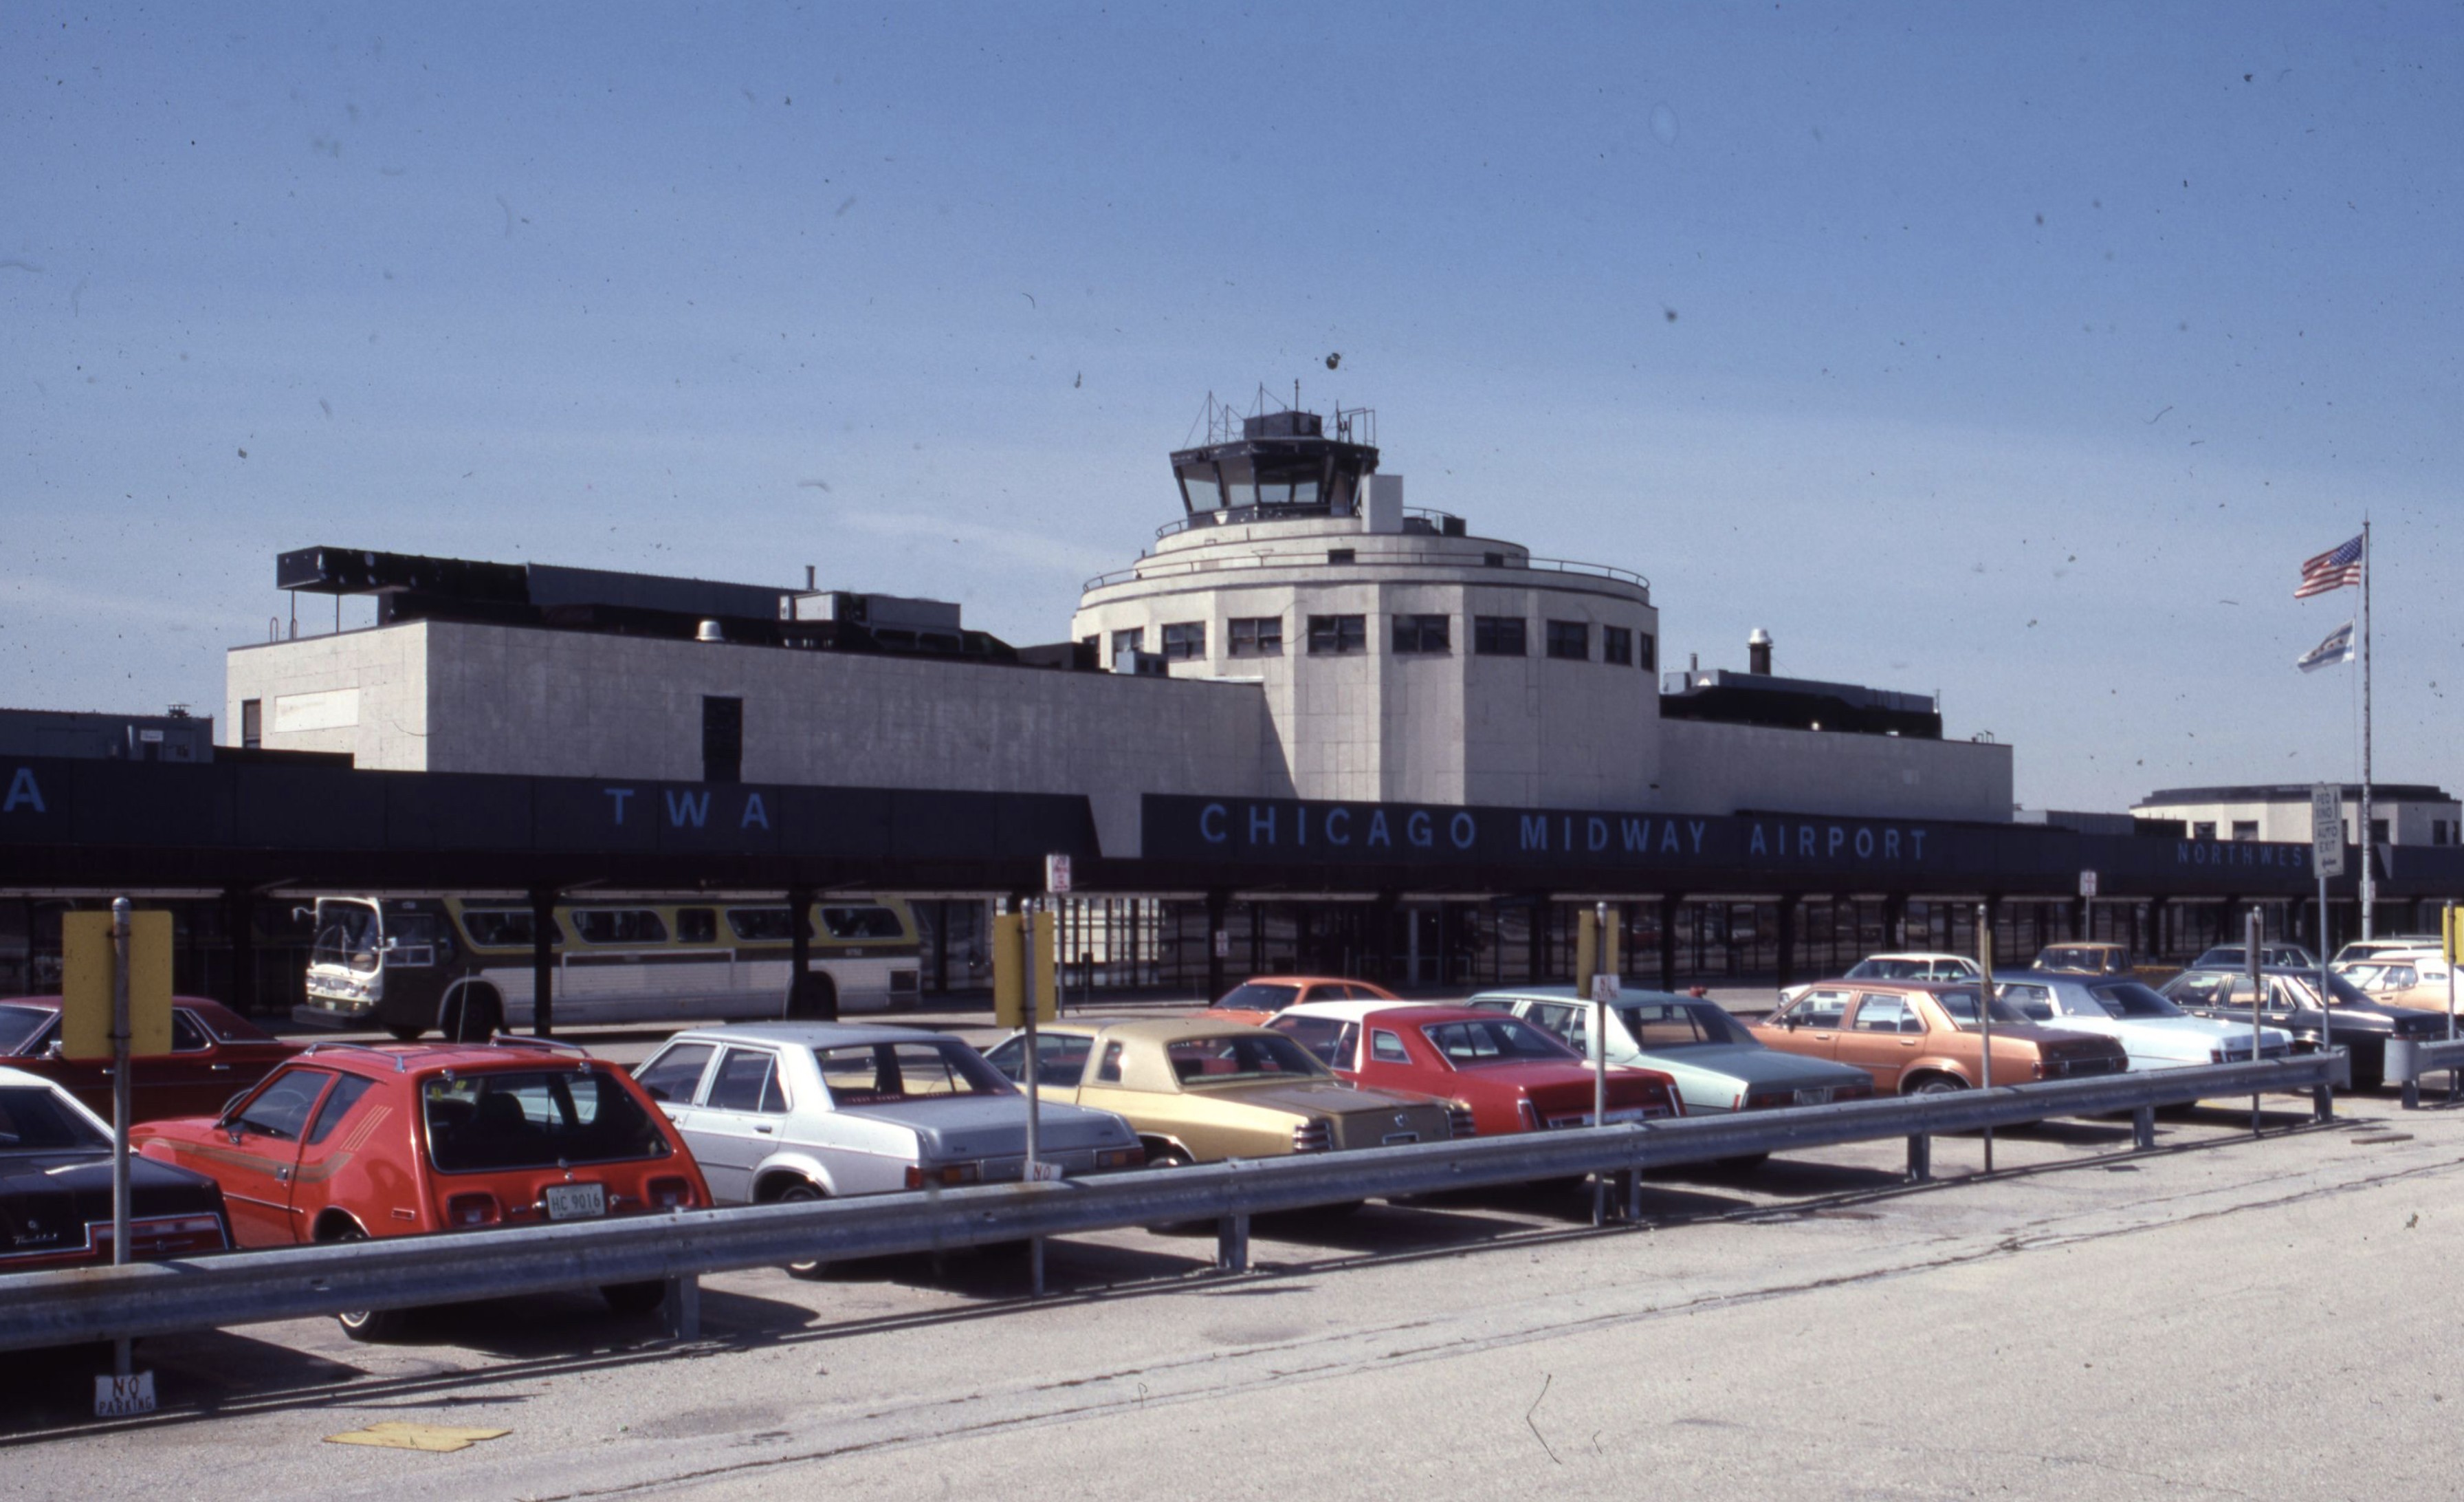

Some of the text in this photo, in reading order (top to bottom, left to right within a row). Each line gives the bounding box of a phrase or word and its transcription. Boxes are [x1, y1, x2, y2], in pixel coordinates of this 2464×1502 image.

[3, 768, 45, 812] A
[1200, 803, 1926, 860] CHICAGO MIDWAY AIRPORT
[2317, 826, 2337, 838] AUTO
[2319, 840, 2335, 853] EXIT
[1033, 1164, 1051, 1182] NO
[551, 1193, 601, 1211] HC 9016
[112, 1375, 139, 1397] NO
[99, 1396, 153, 1415] PARKING
